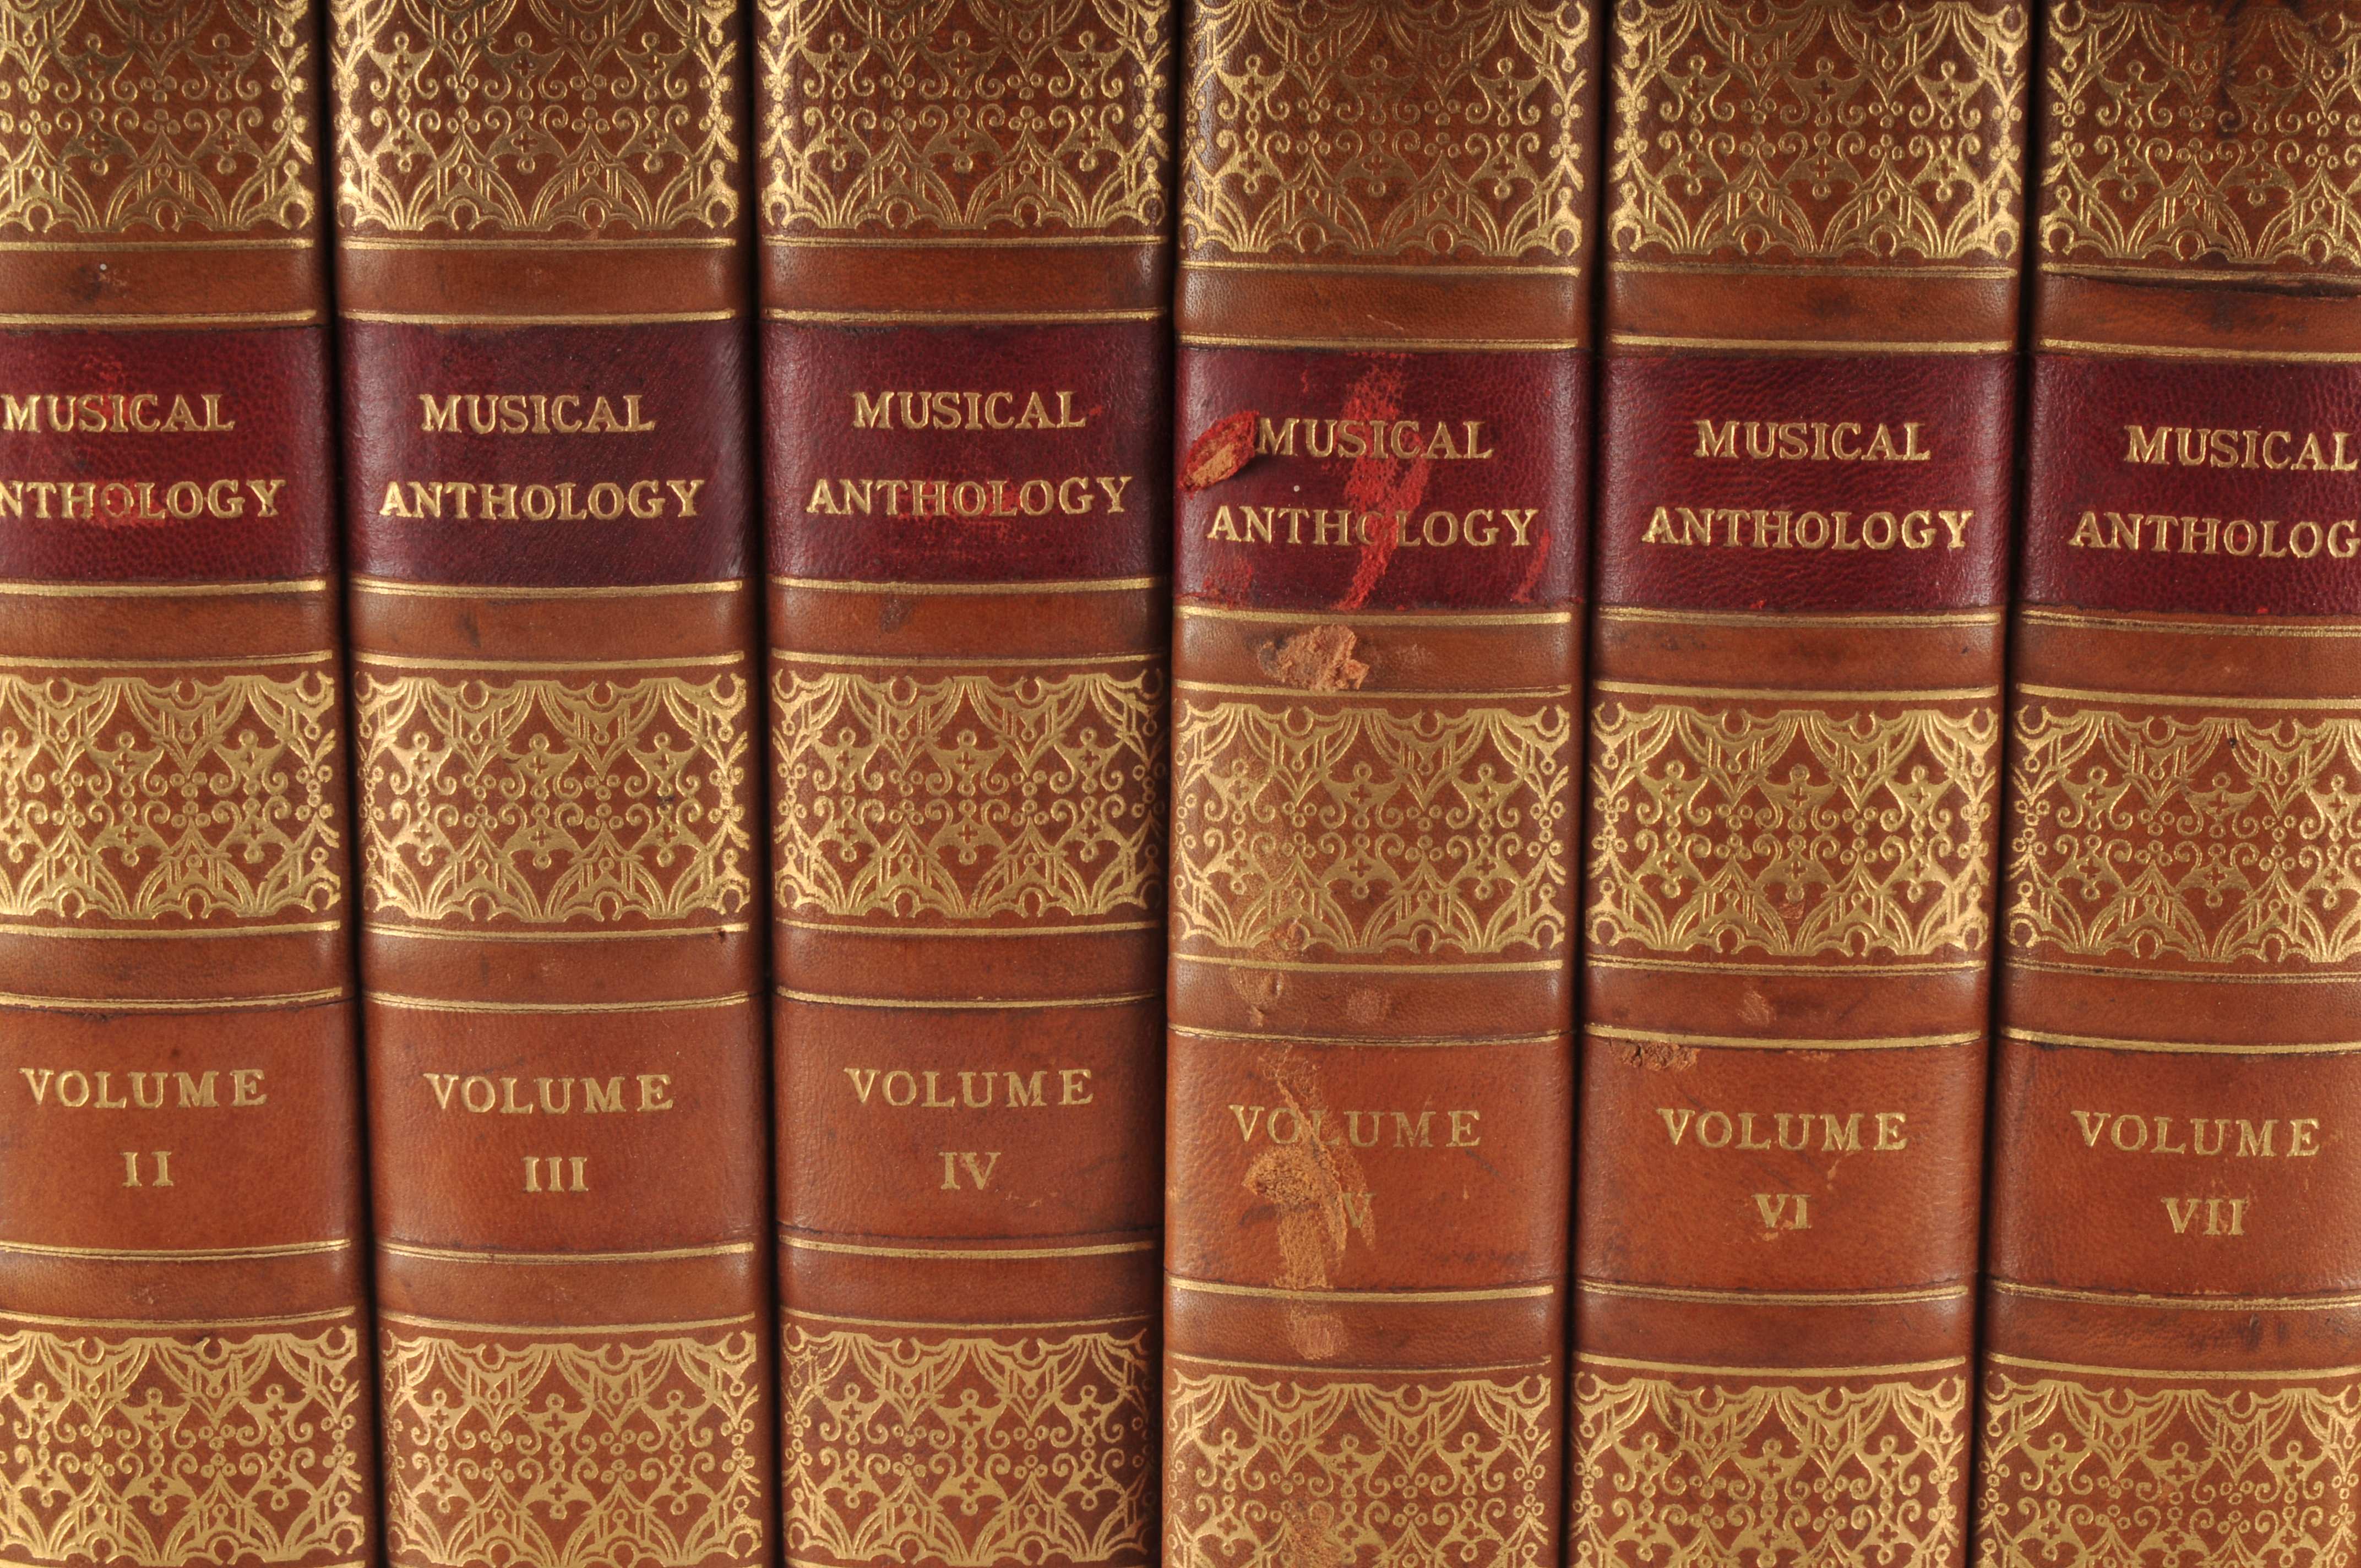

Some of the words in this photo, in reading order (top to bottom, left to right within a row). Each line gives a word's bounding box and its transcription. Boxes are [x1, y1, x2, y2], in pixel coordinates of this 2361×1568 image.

[1, 393, 235, 433] MUSICAL
[419, 393, 655, 434] MUSICAL
[851, 390, 1087, 430] MUSICAL
[1255, 417, 1494, 459] MUSICAL
[1693, 418, 1931, 461] MUSICAL
[2123, 424, 2359, 472] MUSICAL
[0, 478, 286, 519] NTHOLOGY
[379, 479, 705, 520] ANTHOLOGY
[805, 476, 1133, 517] ANTHOLOGY
[1207, 504, 1539, 547] ANTHOLOGY
[1641, 506, 1976, 550] ANTHOLOGY
[2067, 510, 2361, 558] ANTHOLOG
[18, 1067, 268, 1109] VOLUME
[423, 1072, 674, 1114] VOLUME
[843, 1068, 1094, 1108] VOLUME
[1228, 1104, 1482, 1148] VOLUME
[1656, 1108, 1908, 1151] VOLUME
[2070, 1110, 2320, 1157] VOLUME
[121, 1151, 175, 1188] II
[521, 1156, 589, 1193] III
[938, 1151, 1002, 1190] IV
[1341, 1191, 1377, 1229] V
[1751, 1193, 1813, 1230] VI
[2161, 1197, 2248, 1236] VII
